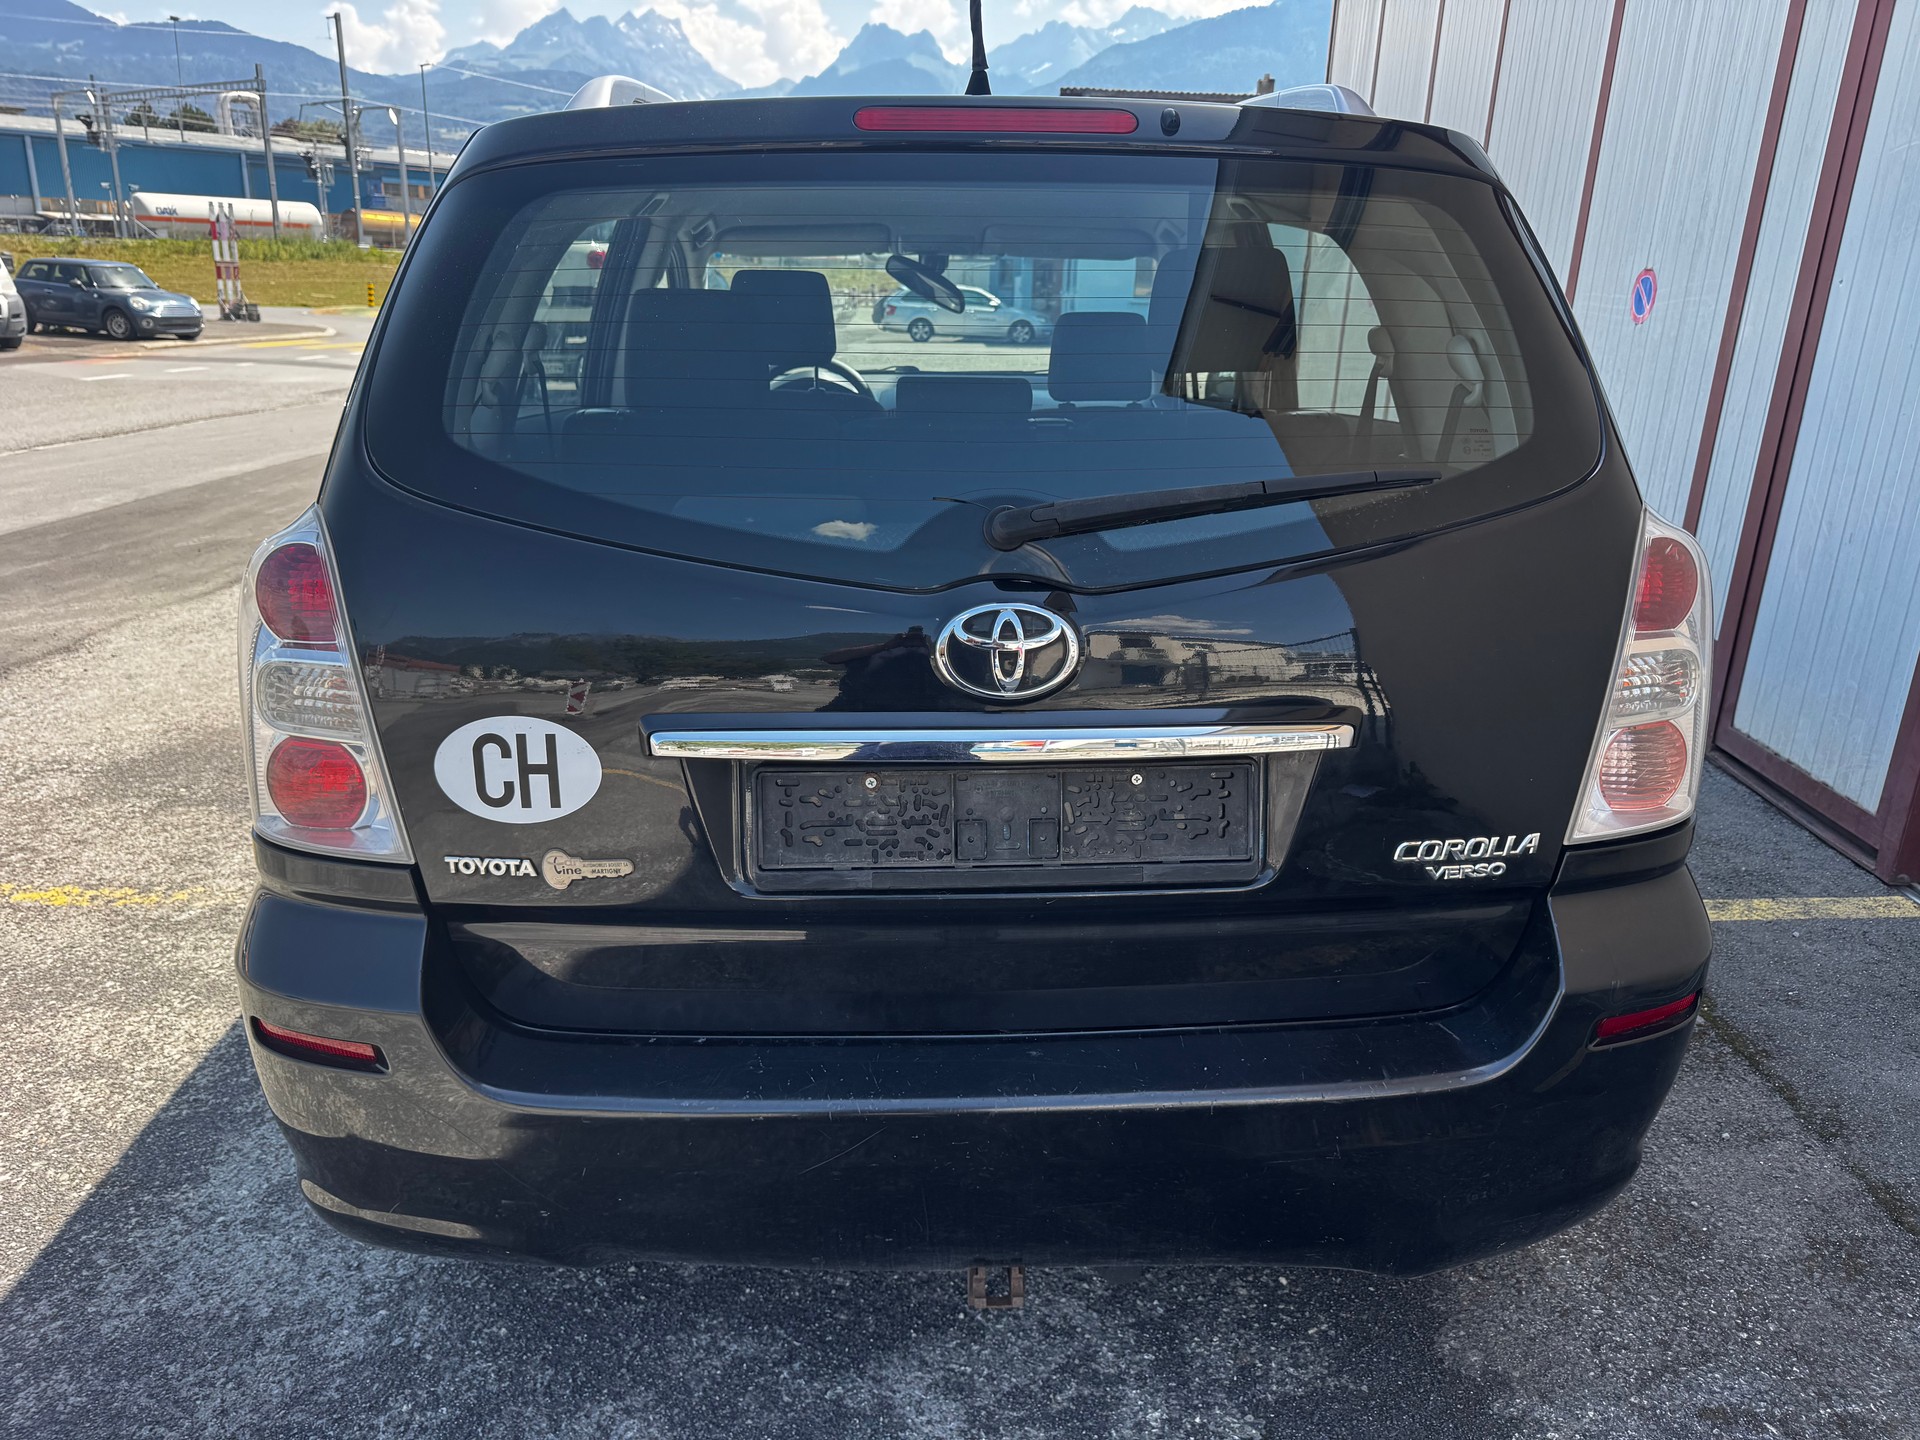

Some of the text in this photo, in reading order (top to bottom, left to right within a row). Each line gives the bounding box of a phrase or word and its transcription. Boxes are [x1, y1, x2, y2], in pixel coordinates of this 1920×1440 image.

[472, 733, 562, 809] CH
[1393, 832, 1541, 862] COROLLA
[443, 856, 538, 877] TOYOTA
[1425, 861, 1507, 880] VERSO
